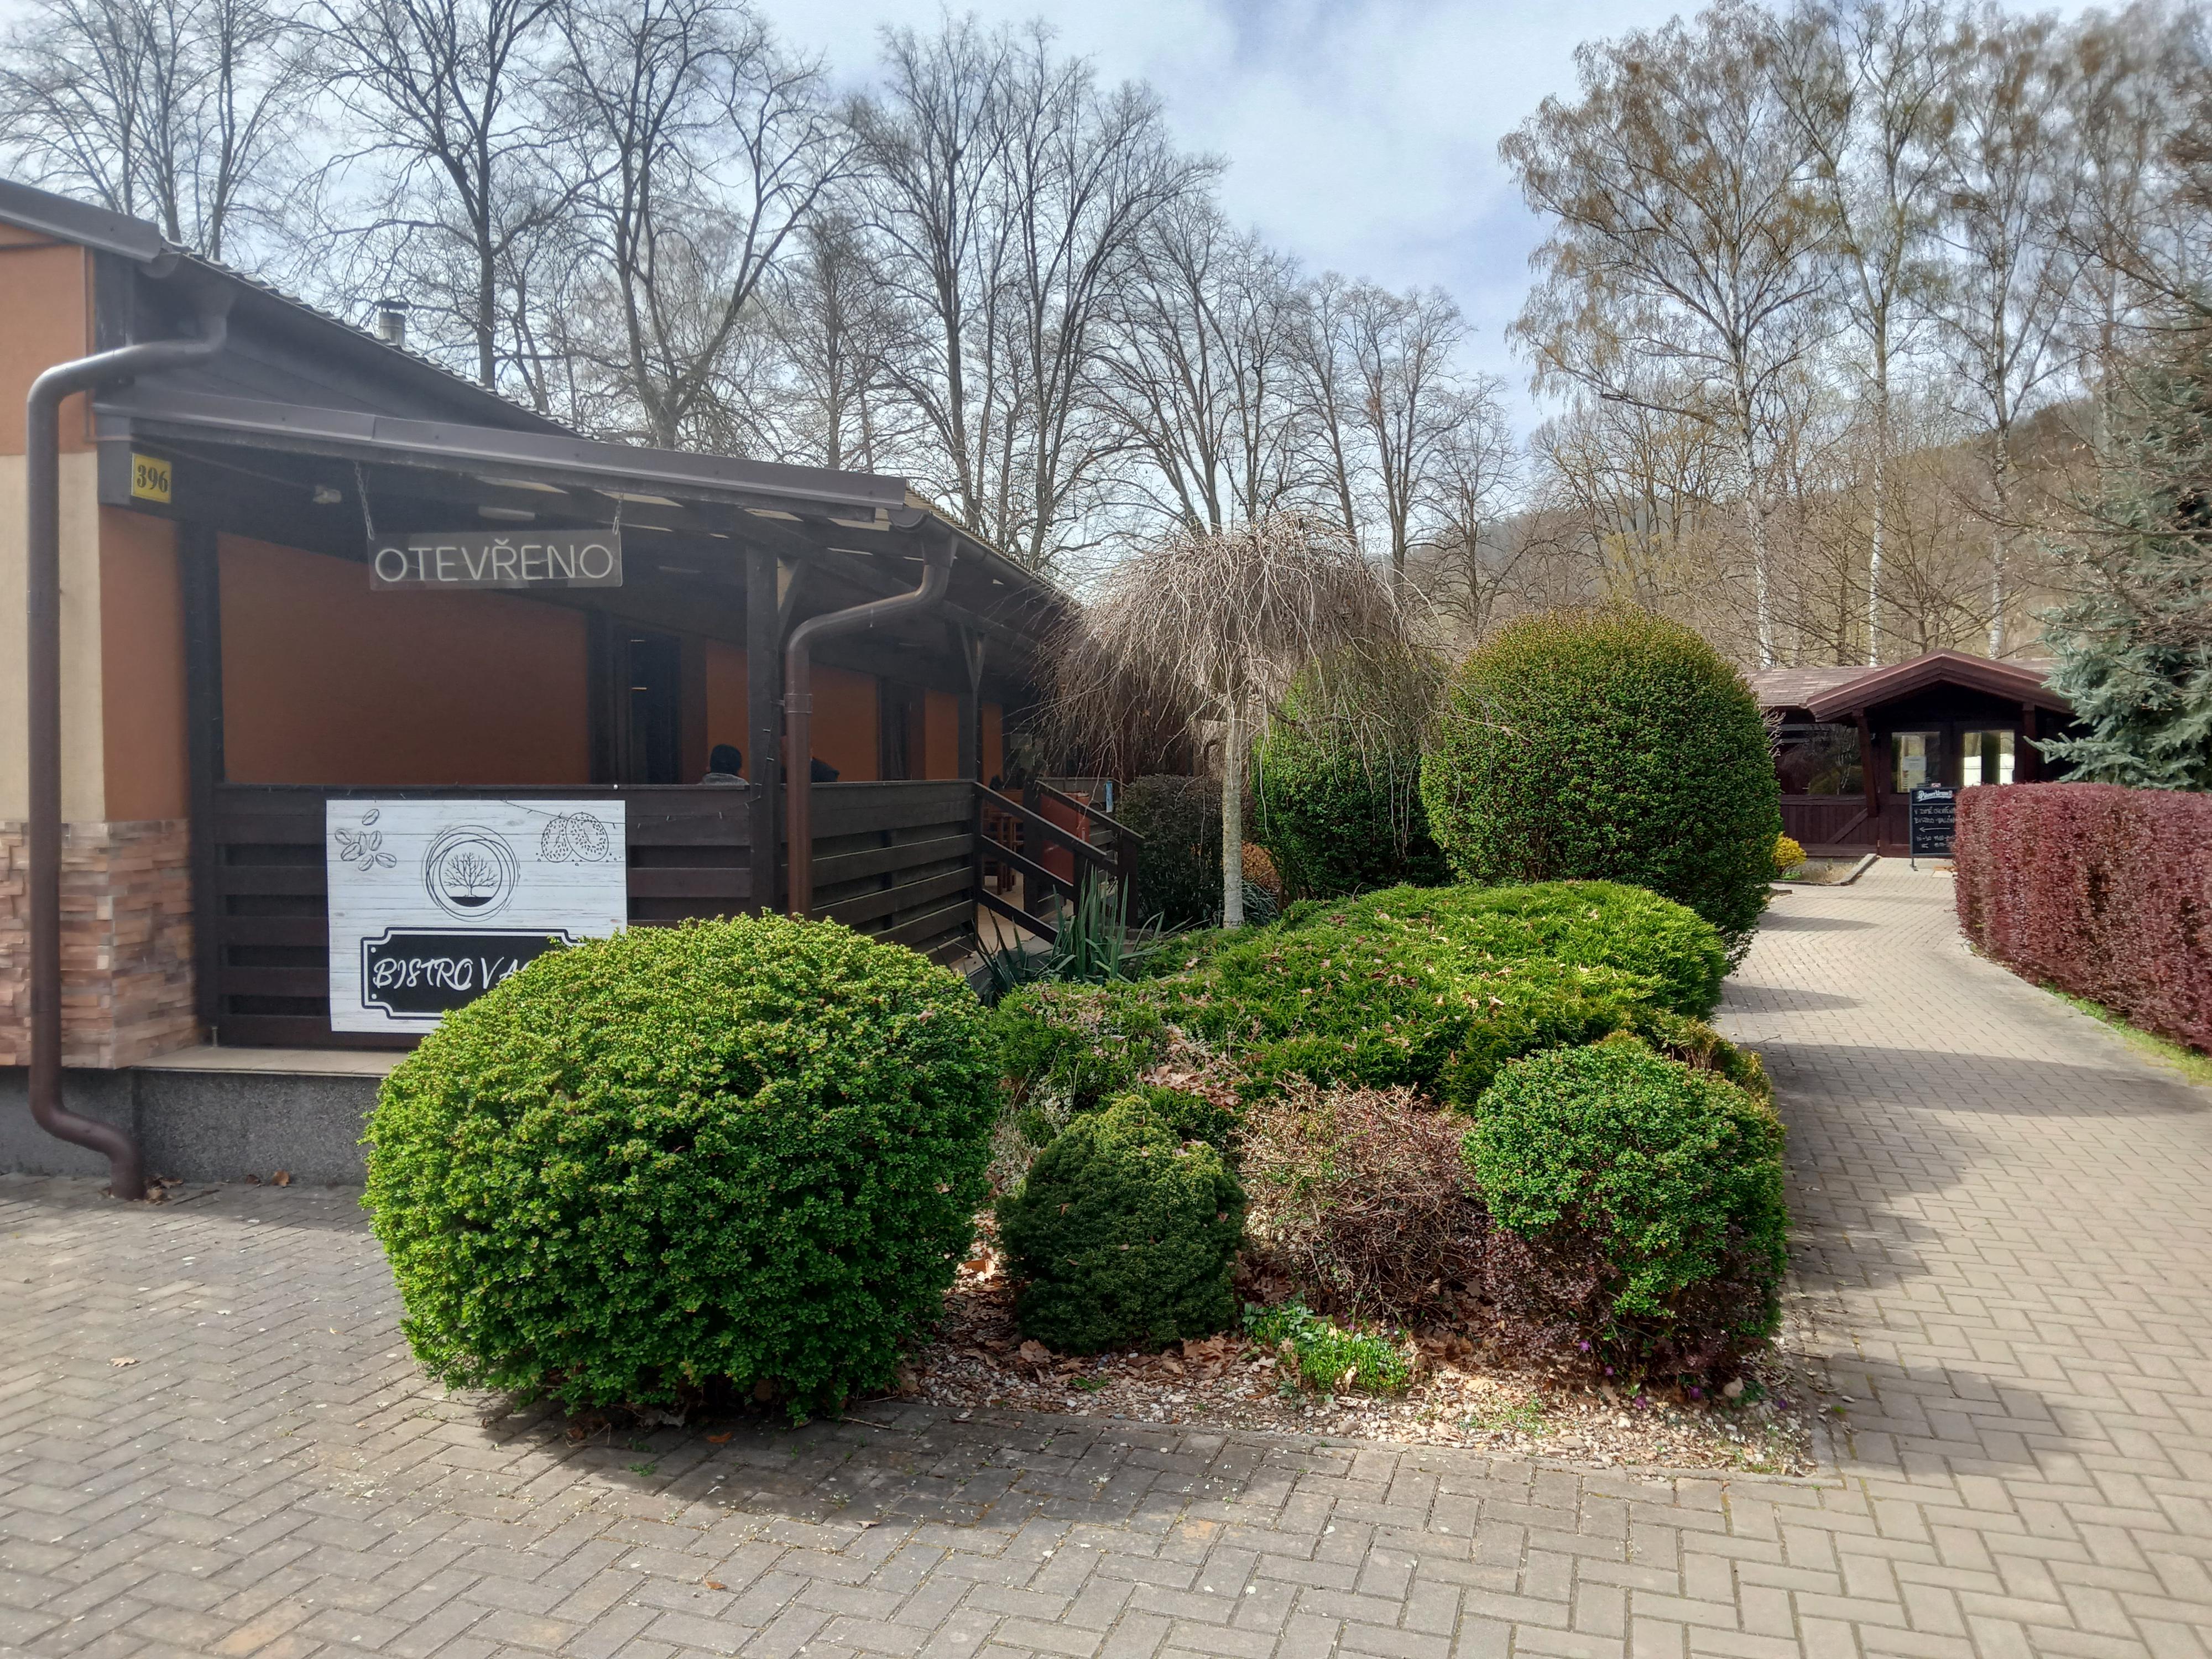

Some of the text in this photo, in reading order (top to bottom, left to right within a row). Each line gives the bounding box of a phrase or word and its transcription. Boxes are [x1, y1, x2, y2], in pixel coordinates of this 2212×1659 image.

[137, 465, 169, 493] 396
[375, 538, 613, 582] OTEVŘENO
[373, 958, 473, 990] BISTRO
